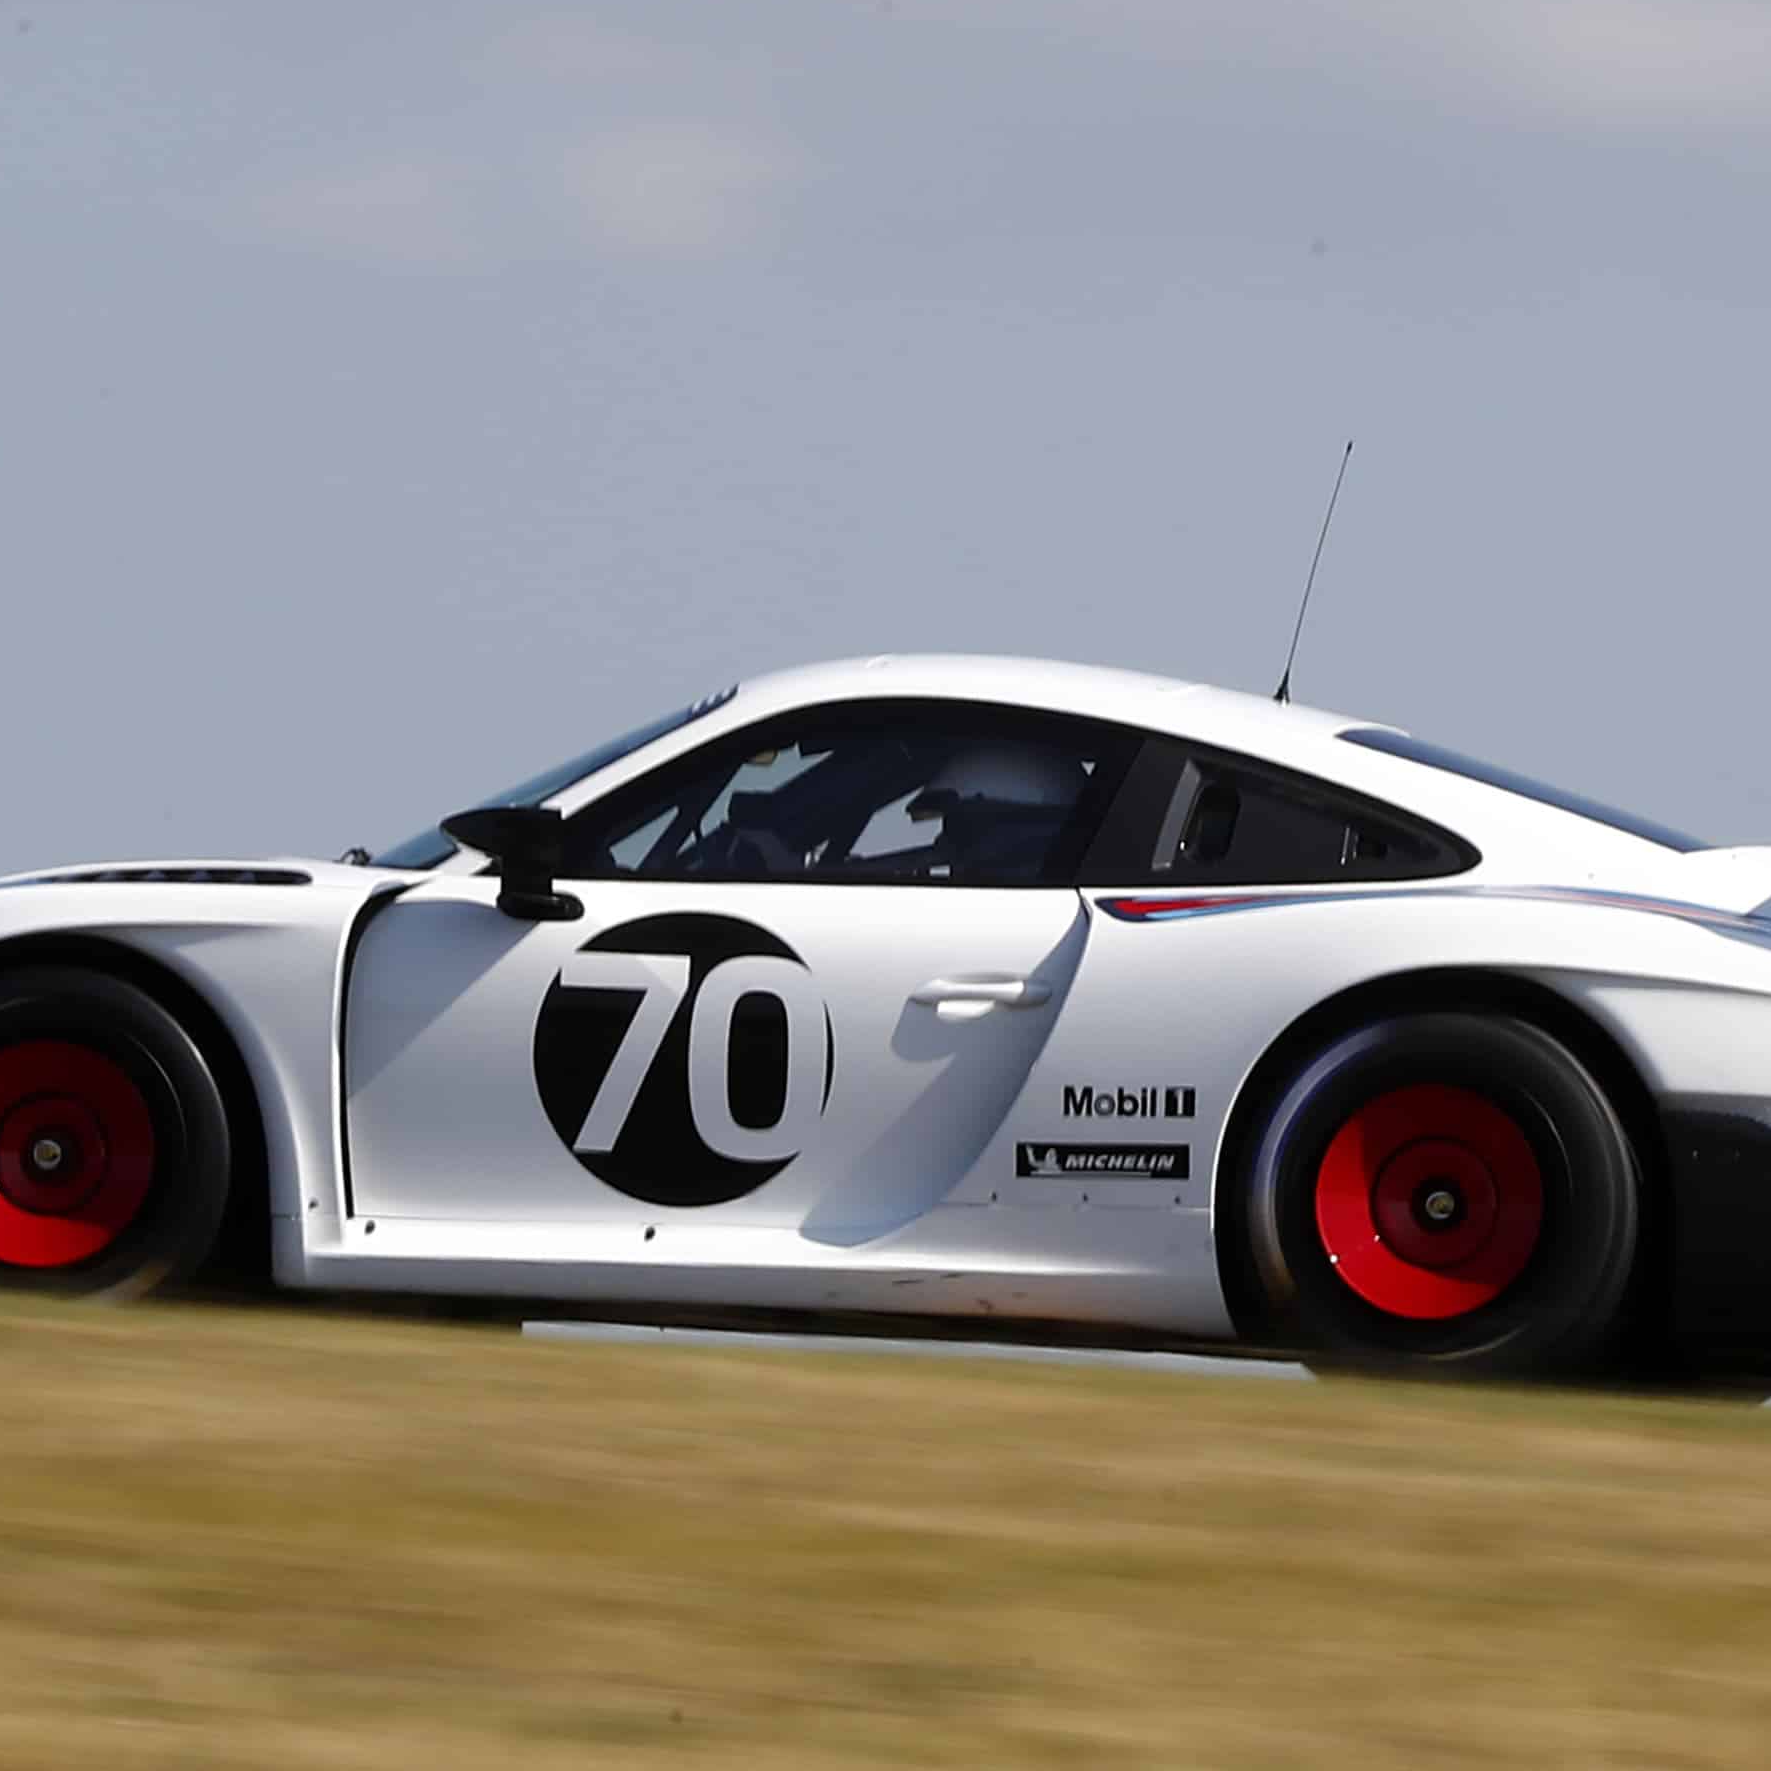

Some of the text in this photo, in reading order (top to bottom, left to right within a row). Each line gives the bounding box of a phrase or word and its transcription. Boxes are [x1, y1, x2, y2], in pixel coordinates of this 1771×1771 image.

[559, 949, 828, 1162] 70
[1063, 1085, 1157, 1117] Mobil
[1065, 1154, 1175, 1171] MICHELIN
